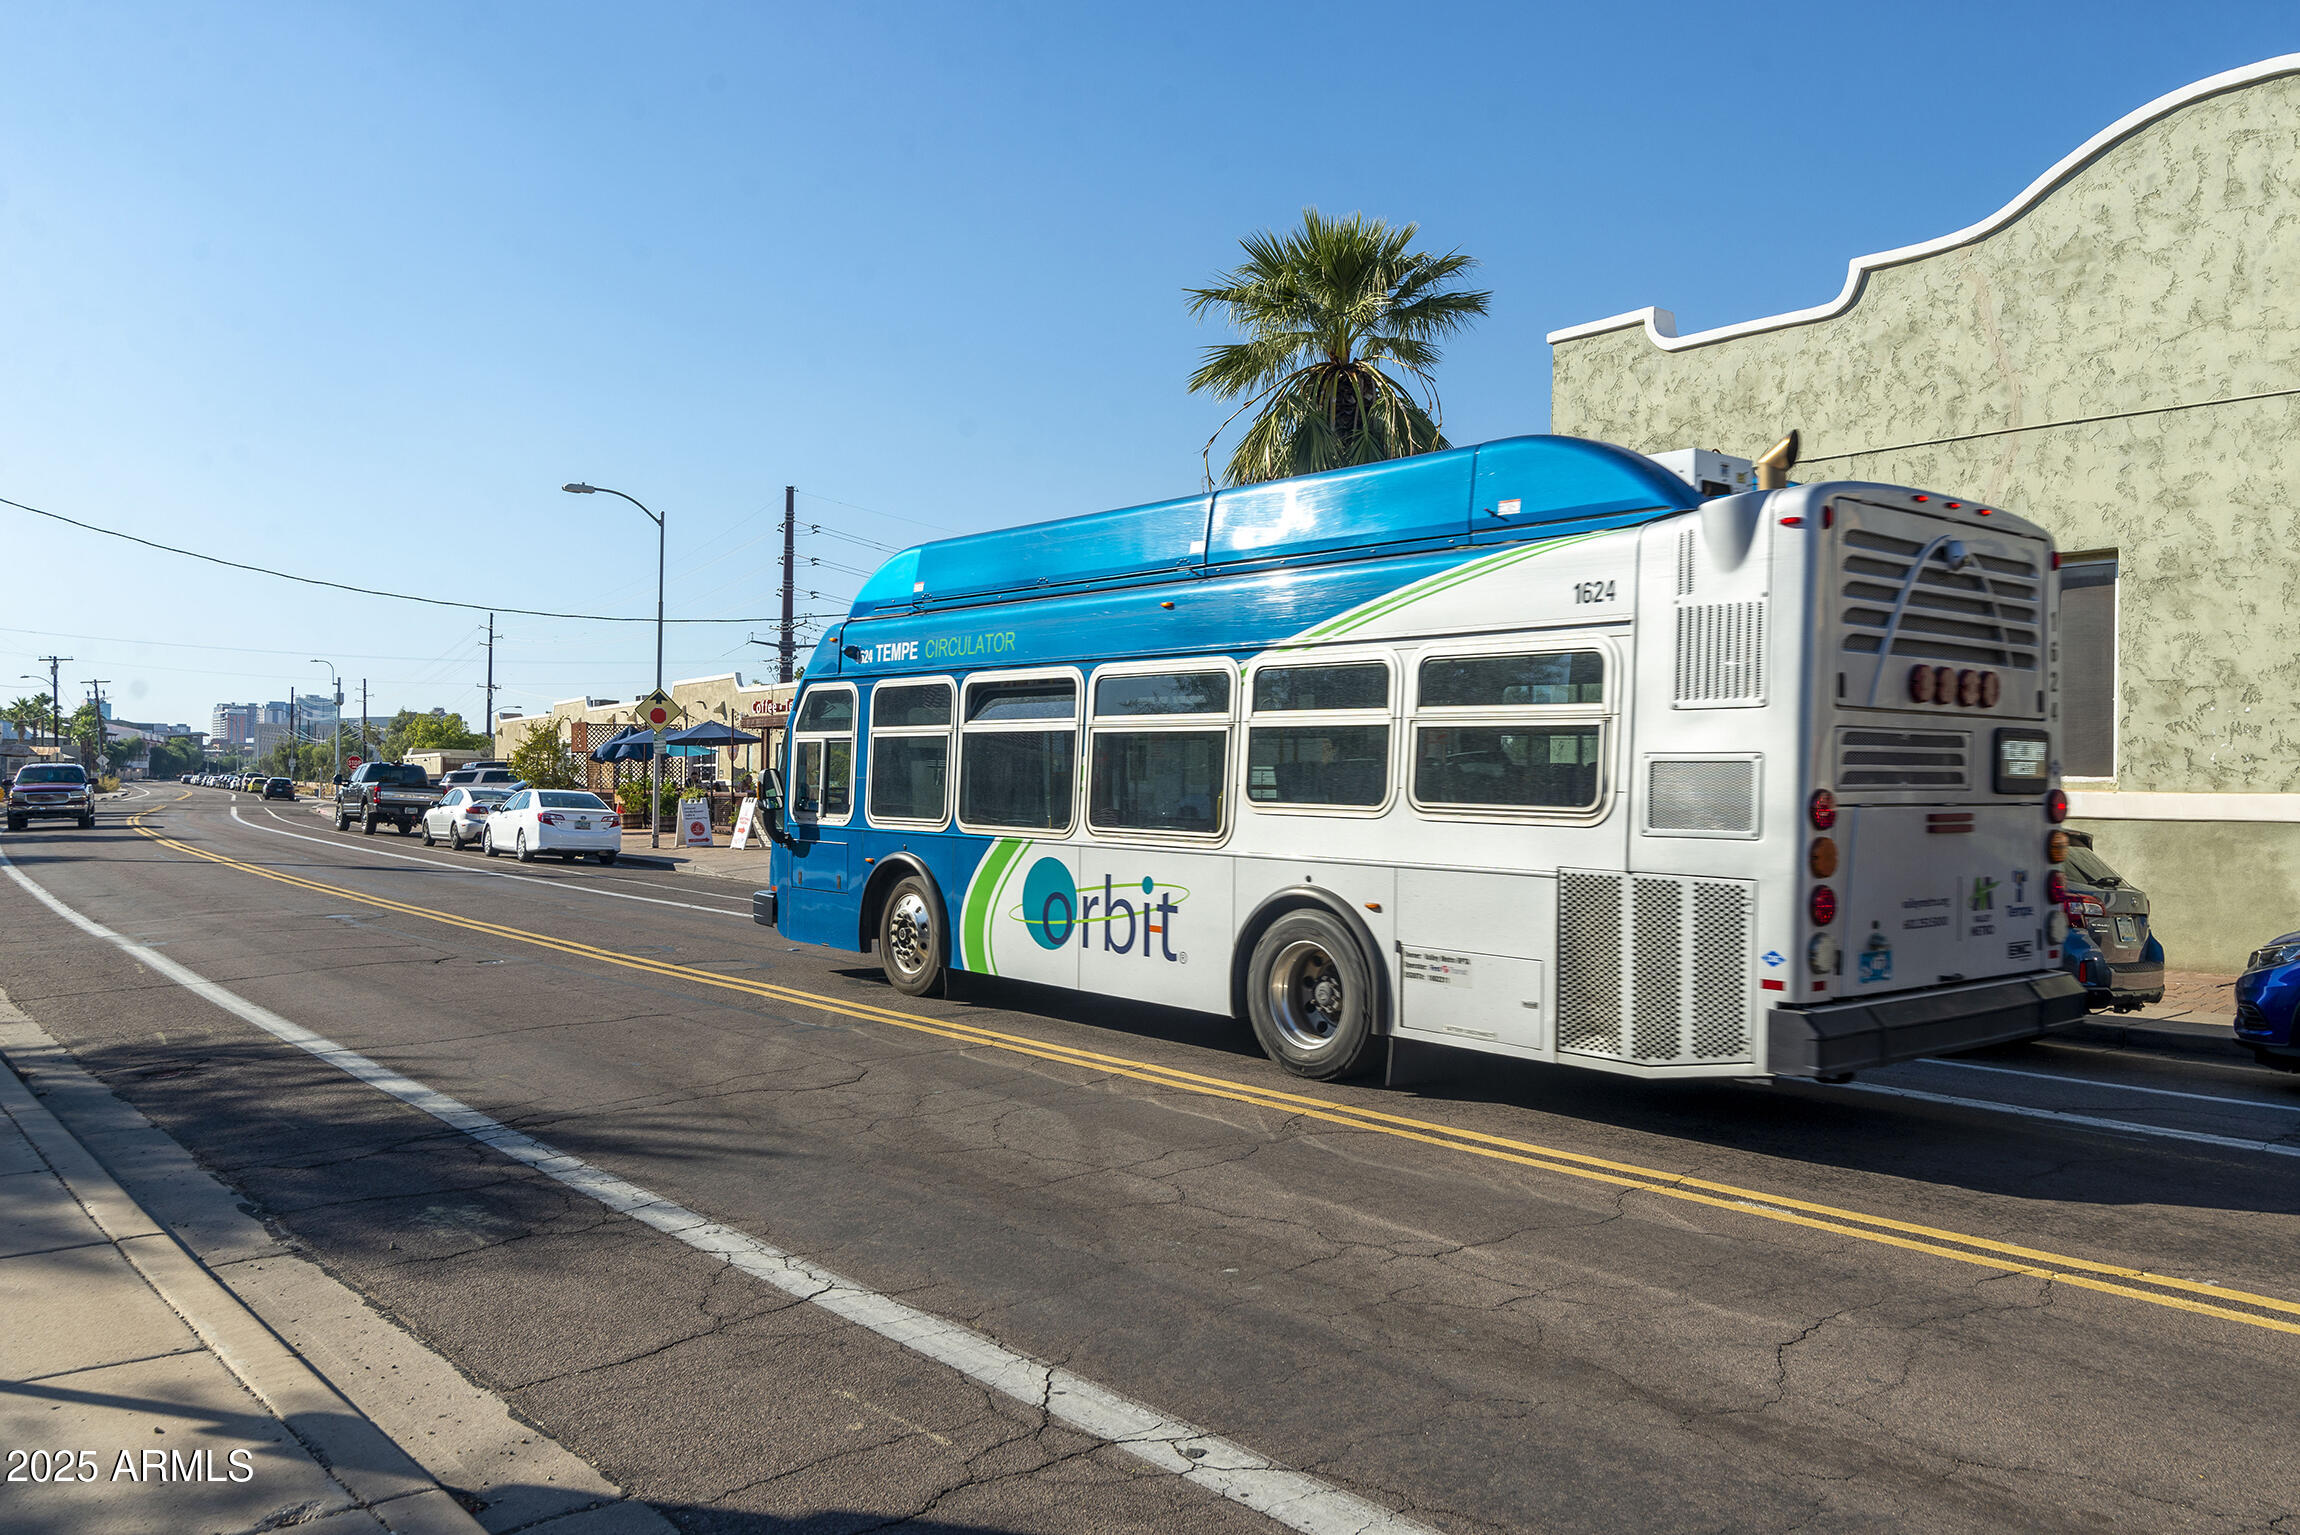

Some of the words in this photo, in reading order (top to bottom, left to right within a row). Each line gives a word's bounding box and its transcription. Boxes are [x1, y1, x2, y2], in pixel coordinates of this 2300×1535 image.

[1574, 580, 1616, 604] 1624
[857, 649, 873, 664] 624
[876, 641, 919, 662] TEMPE
[925, 631, 1016, 658] CIRCULATOR
[751, 700, 777, 713] Coffee
[1042, 873, 1179, 962] orbit
[2005, 904, 2034, 918] Tempe
